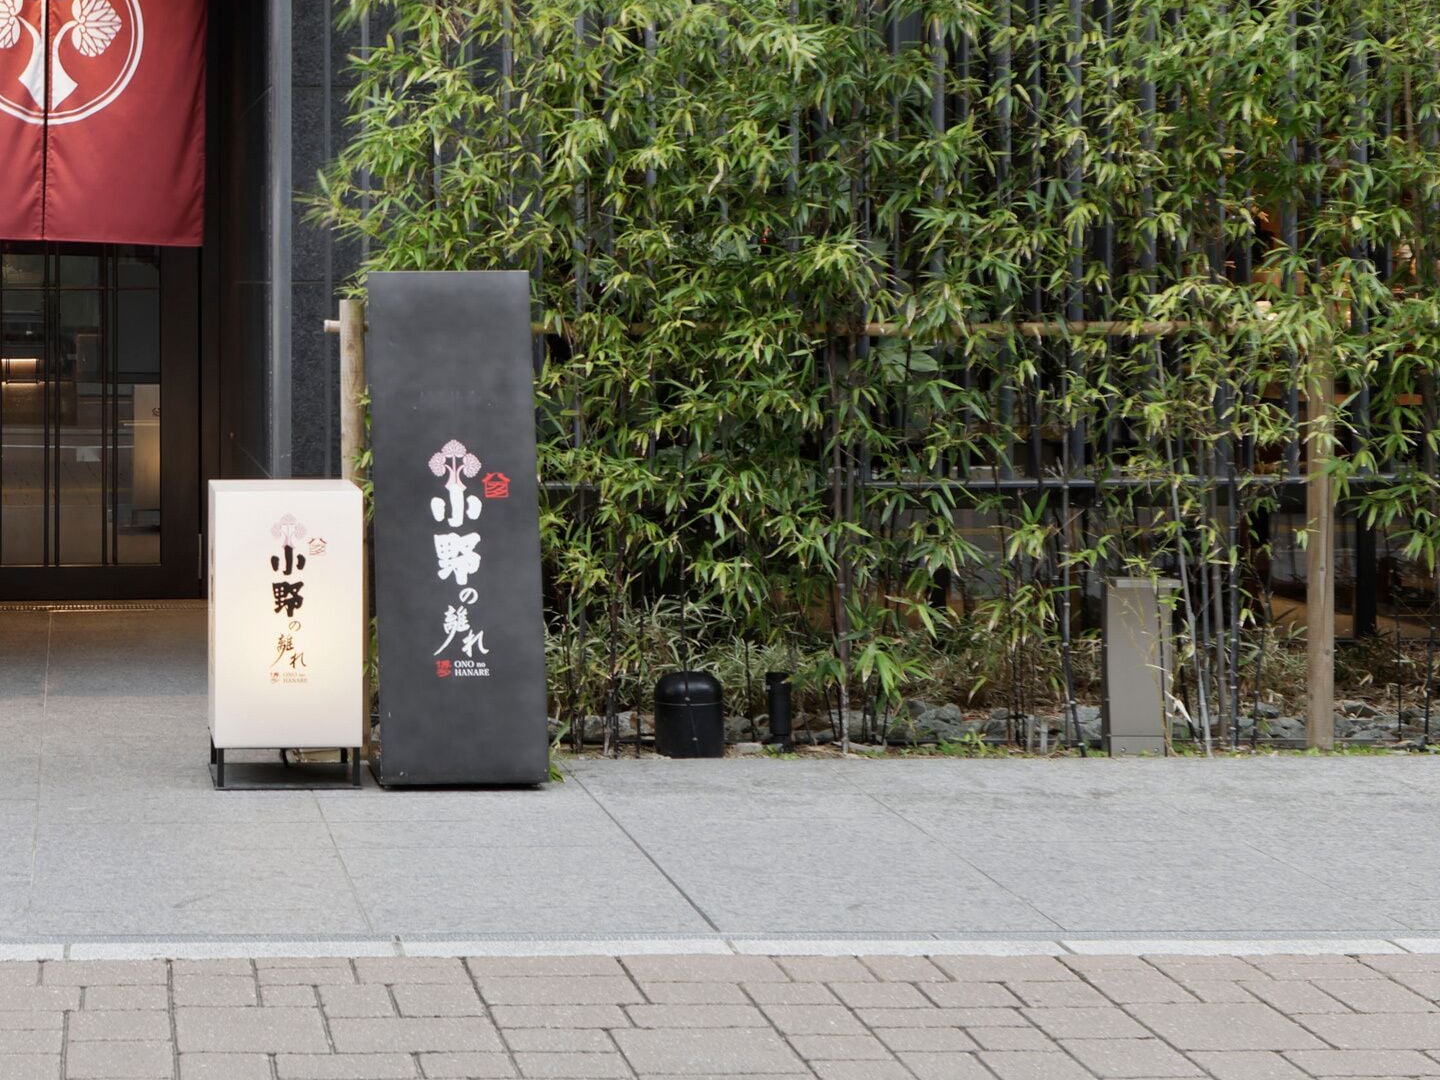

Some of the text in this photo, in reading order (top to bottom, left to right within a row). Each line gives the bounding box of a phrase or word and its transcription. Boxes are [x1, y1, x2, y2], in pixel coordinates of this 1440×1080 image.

[430, 481, 491, 658] 小野の離れ
[270, 544, 307, 669] 小野の離れ
[453, 659, 487, 669] ONO no
[453, 668, 491, 677] HANARE
